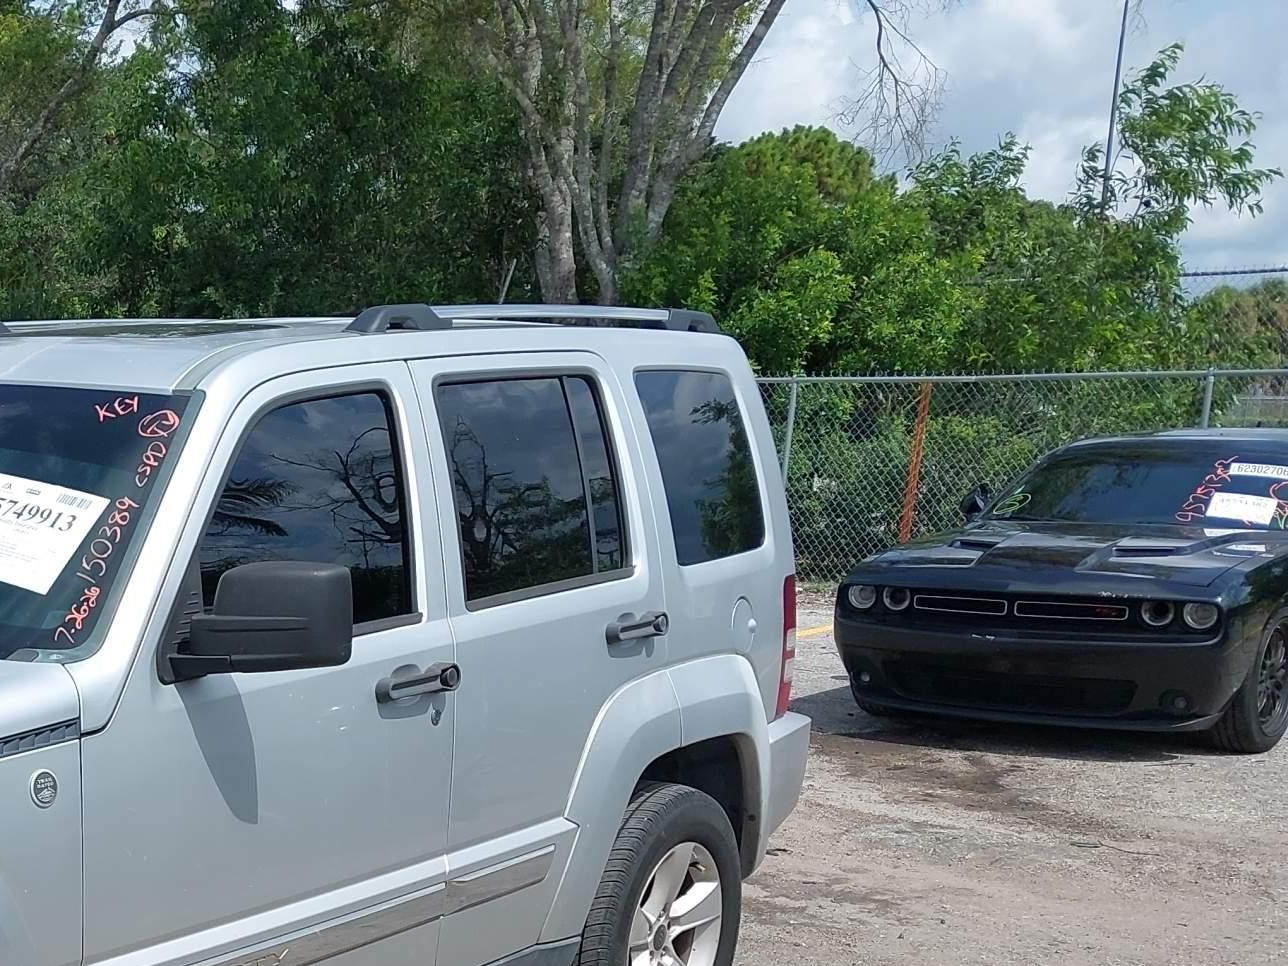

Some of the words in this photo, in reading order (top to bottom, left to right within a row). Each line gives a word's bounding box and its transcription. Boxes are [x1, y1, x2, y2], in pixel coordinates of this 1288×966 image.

[95, 396, 139, 422] KEY
[77, 497, 140, 583] 150389
[135, 441, 167, 488] CSPD
